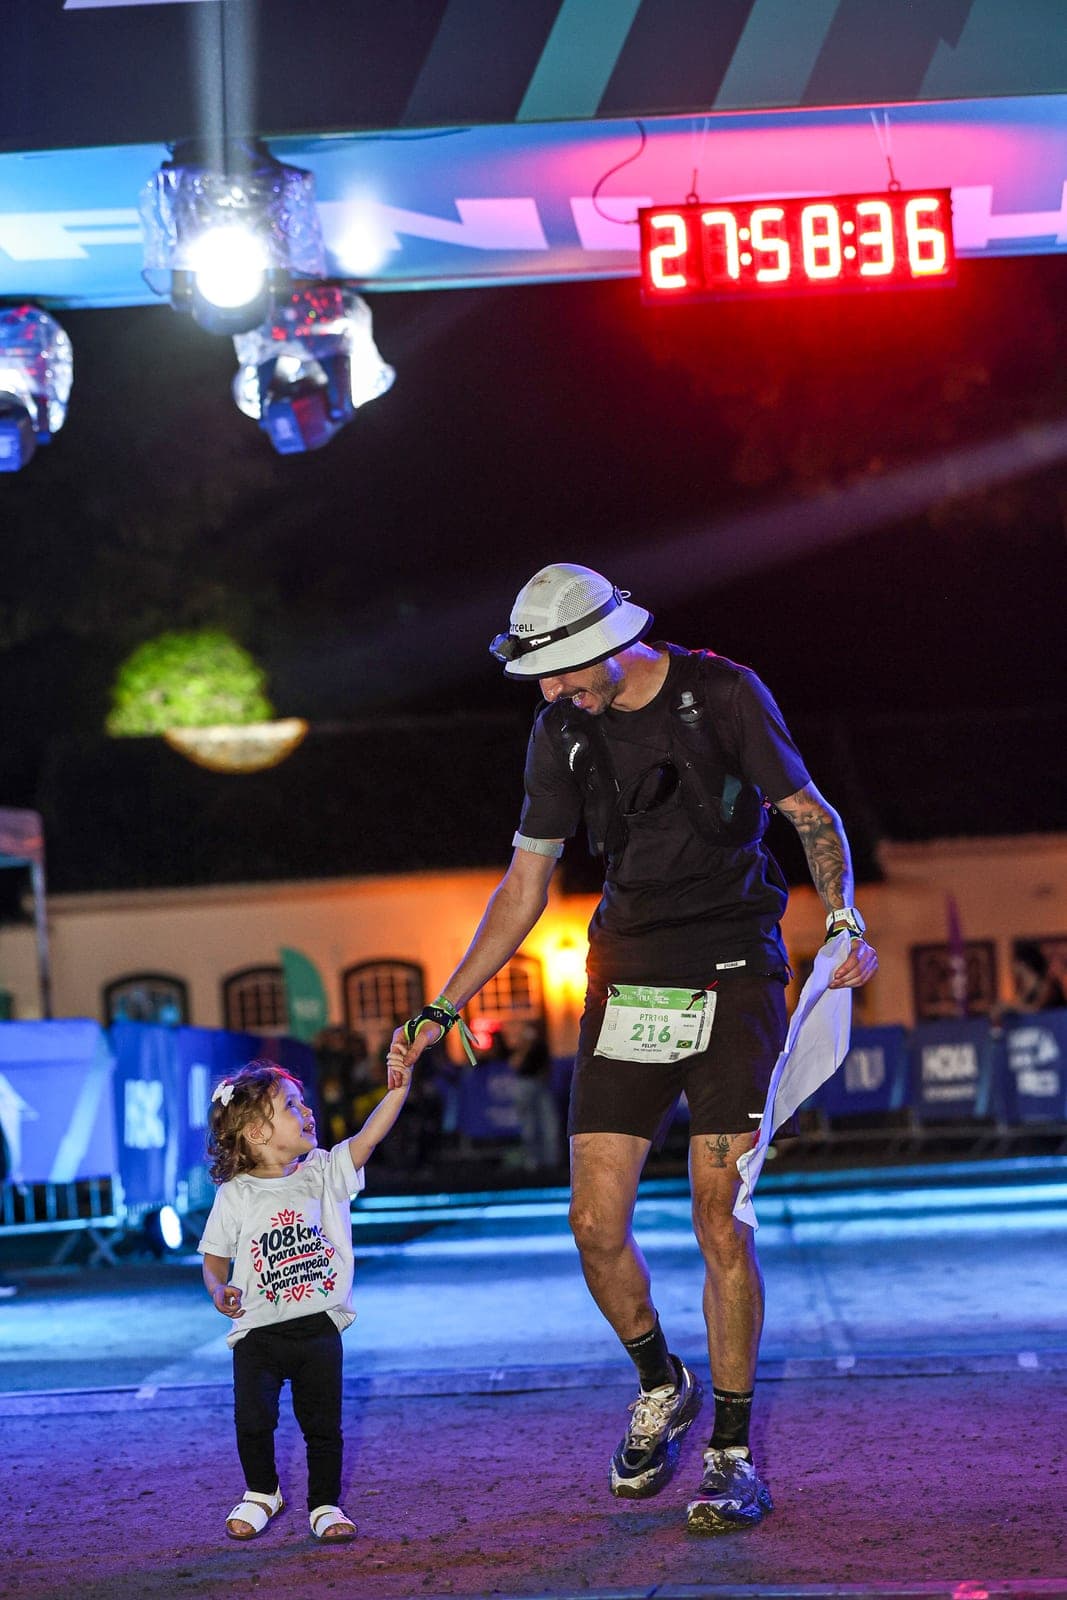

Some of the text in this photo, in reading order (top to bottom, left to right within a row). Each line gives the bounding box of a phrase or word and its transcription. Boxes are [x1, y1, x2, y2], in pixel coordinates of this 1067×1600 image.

[648, 196, 947, 290] 27:58:36
[630, 1023, 671, 1044] 216
[259, 1224, 321, 1257] 108 km
[268, 1237, 325, 1269] para você.
[260, 1255, 329, 1286] Um campeão
[271, 1269, 327, 1296] para mim.
